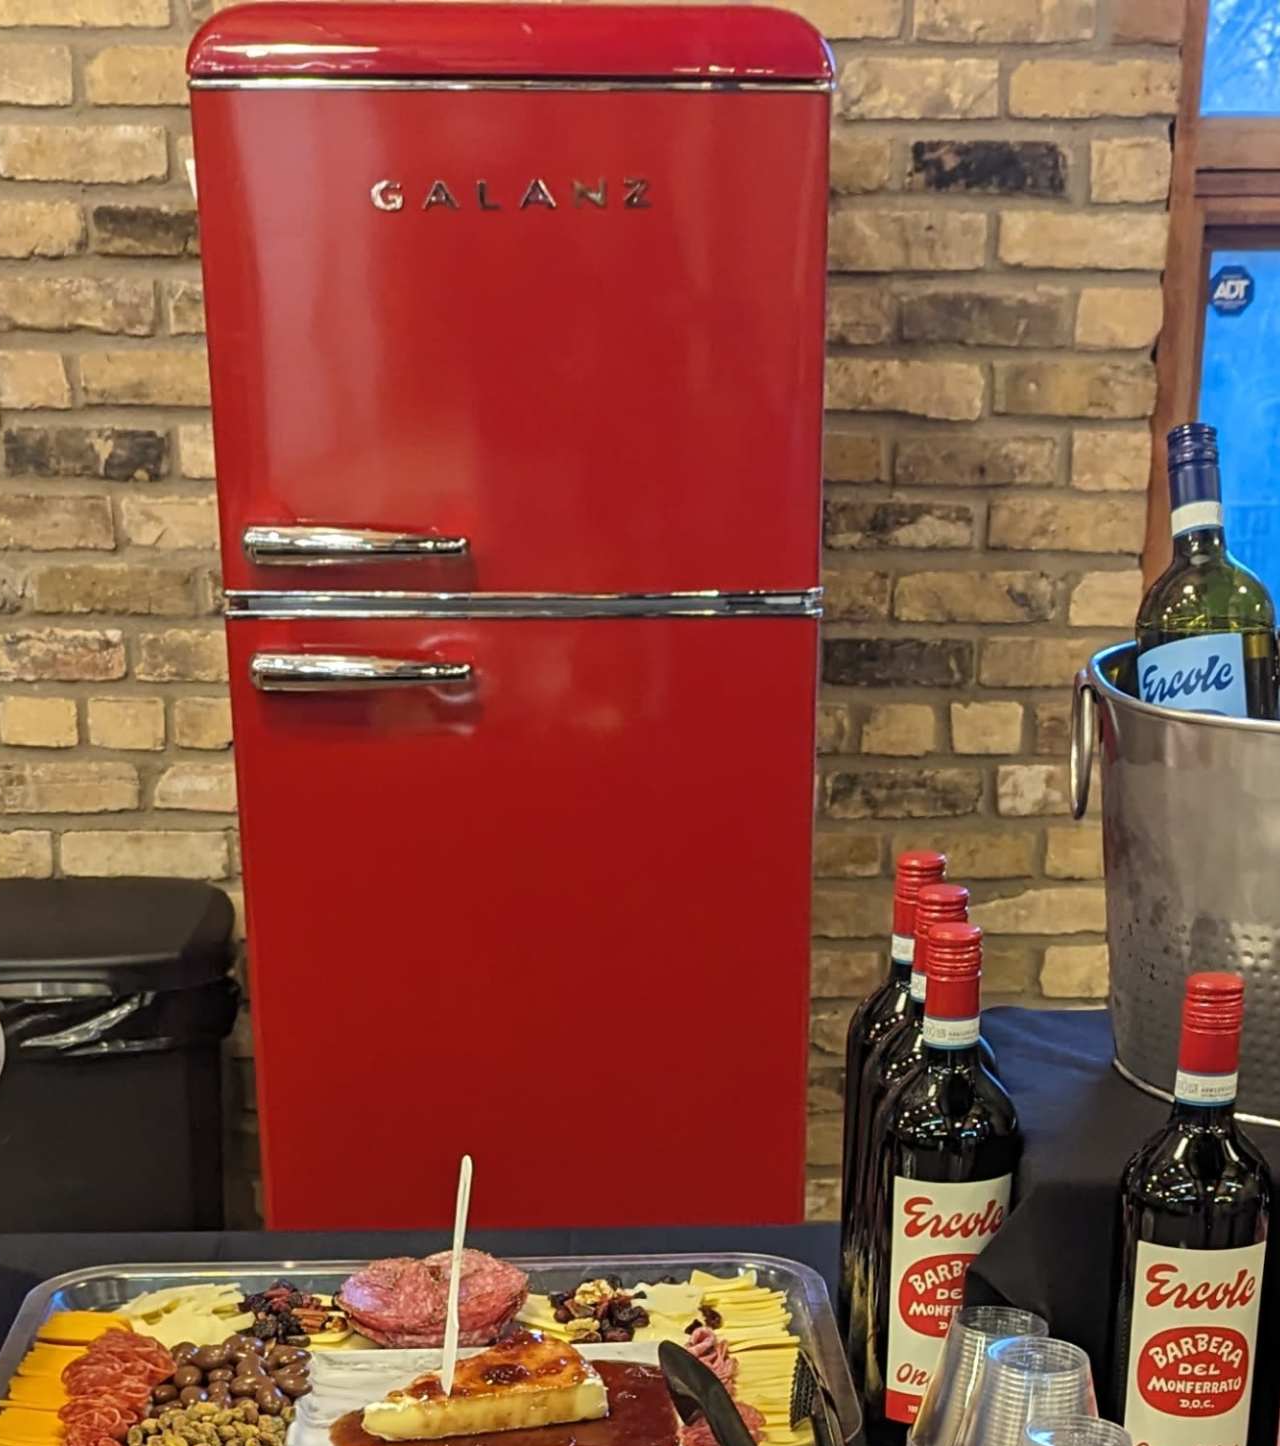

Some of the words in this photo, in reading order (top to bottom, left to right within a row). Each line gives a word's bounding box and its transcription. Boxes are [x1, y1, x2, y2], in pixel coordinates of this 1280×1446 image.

[370, 179, 651, 211] GALANZ
[1213, 279, 1251, 300] ADT
[1143, 654, 1234, 702] Ercole
[903, 1196, 1004, 1238] Ercole
[908, 1260, 969, 1295] BARB
[1146, 1263, 1256, 1310] Ercole
[936, 1288, 962, 1300] DE
[1148, 1333, 1243, 1369] BARBERA
[896, 1362, 929, 1386] On
[1178, 1363, 1221, 1376] DEL
[1147, 1376, 1242, 1394] MONFERRATO
[1179, 1399, 1215, 1409] D.O.C.
